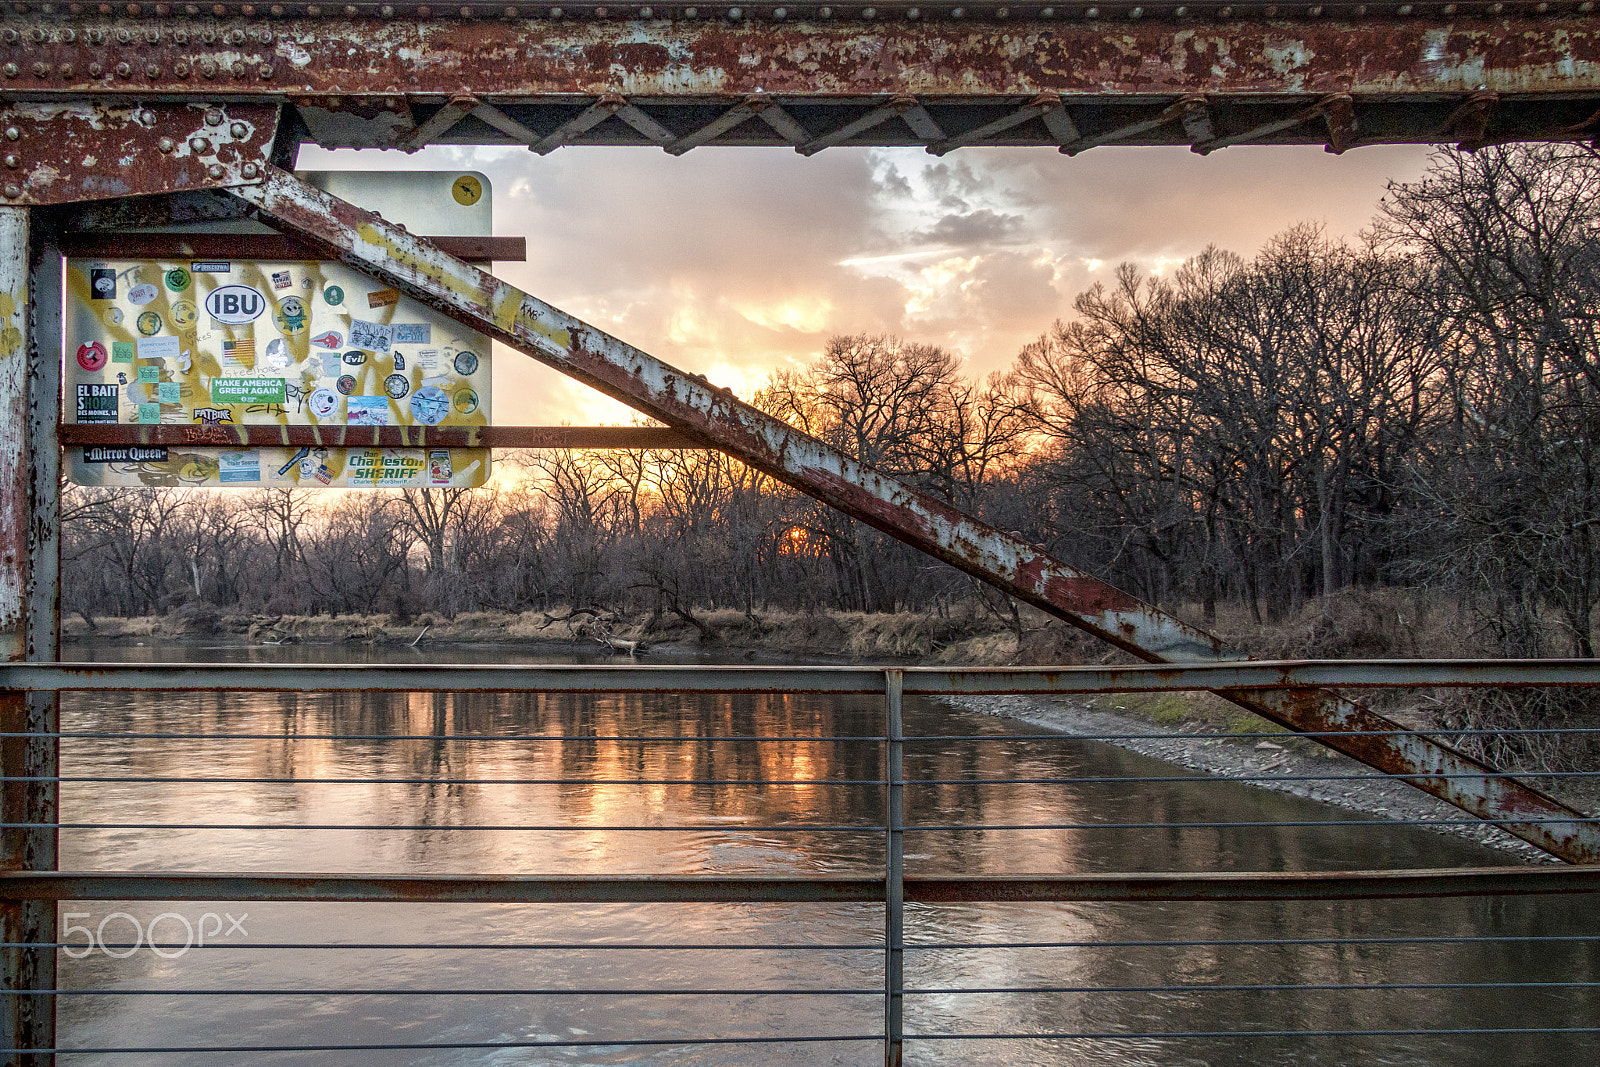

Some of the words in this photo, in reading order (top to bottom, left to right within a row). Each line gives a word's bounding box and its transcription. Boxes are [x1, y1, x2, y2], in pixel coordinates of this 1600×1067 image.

[214, 294, 258, 315] IBU
[344, 355, 365, 363] Evil
[215, 379, 240, 387] MAKE
[242, 379, 282, 387] AMERICA
[77, 385, 90, 397] EL
[92, 385, 118, 397] BAIT
[77, 396, 107, 410] SHOP
[194, 408, 230, 420] FATBIKE
[90, 447, 127, 460] Mirror
[129, 447, 161, 460] Queen
[364, 450, 378, 458] Dan
[349, 456, 423, 466] Charleston
[355, 468, 418, 478] SHERIFF
